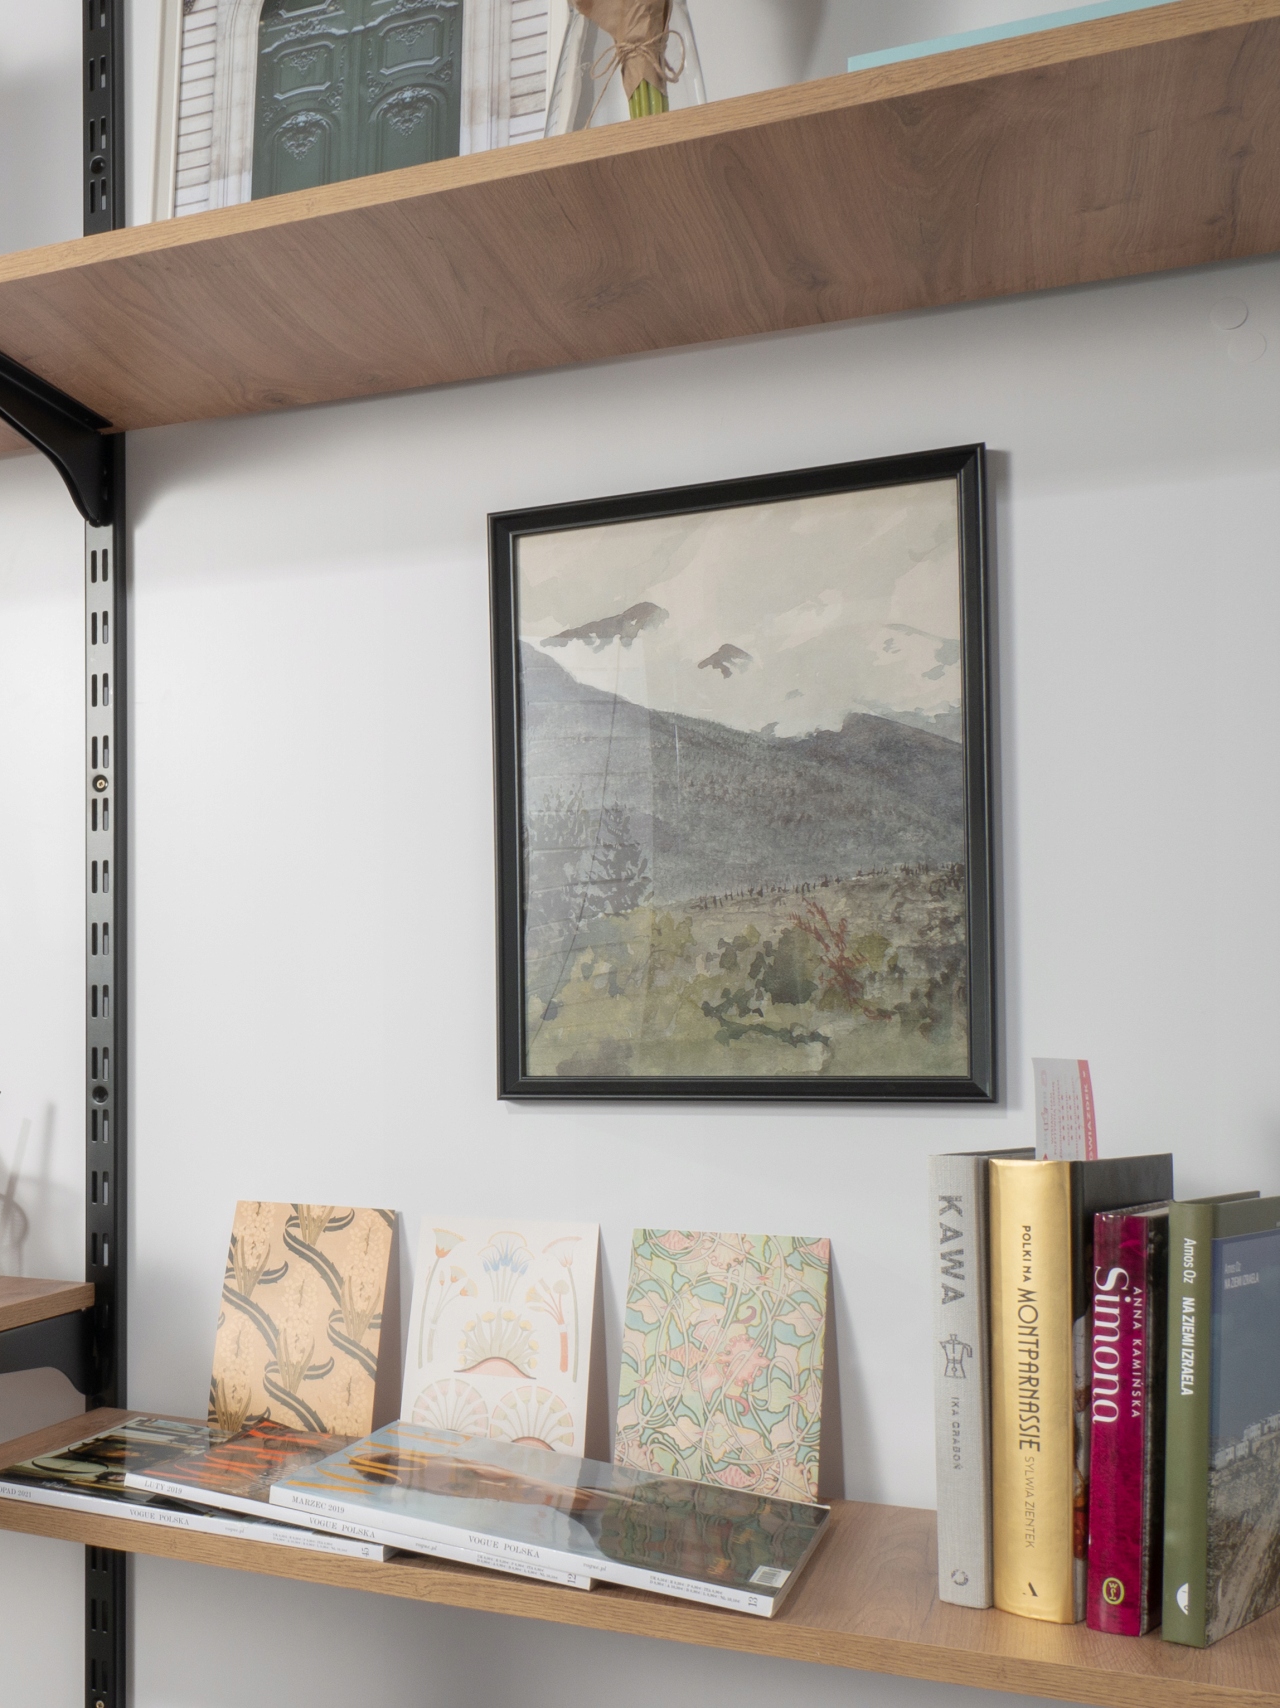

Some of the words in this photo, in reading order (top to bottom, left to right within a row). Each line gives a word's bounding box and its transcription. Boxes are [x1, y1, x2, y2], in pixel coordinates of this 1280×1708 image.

[938, 1195, 965, 1305] KAWA
[1022, 1225, 1032, 1262] POLKI
[1183, 1237, 1197, 1268] Amos
[1022, 1265, 1032, 1283] NA
[1183, 1271, 1197, 1284] Oz
[1133, 1286, 1143, 1330] ANNA
[1182, 1296, 1195, 1314] NA
[1182, 1315, 1195, 1347] ZIEMI
[1092, 1265, 1131, 1424] Simona
[1017, 1287, 1040, 1453] MONTPARNASSIE
[1131, 1338, 1144, 1418] KAMIŃSKA
[1180, 1348, 1195, 1396] IZRAELA
[951, 1396, 959, 1417] IKA
[144, 1479, 166, 1491] LUTY
[167, 1484, 183, 1495] 2019
[1024, 1455, 1034, 1499] SYLWIA
[17, 1489, 32, 1498] 2021
[291, 1495, 327, 1510] MARZEC
[328, 1504, 345, 1514] 2019
[129, 1509, 155, 1520] VOGUE
[159, 1514, 189, 1526] POLSKA
[309, 1517, 338, 1530] VOGUE
[341, 1524, 376, 1539] POLSKA
[1024, 1501, 1035, 1549] ZIENTEK
[468, 1535, 500, 1549] VOGUE
[503, 1543, 540, 1559] POLSKA
[567, 1573, 577, 1584] 12
[747, 1596, 758, 1608] 13
